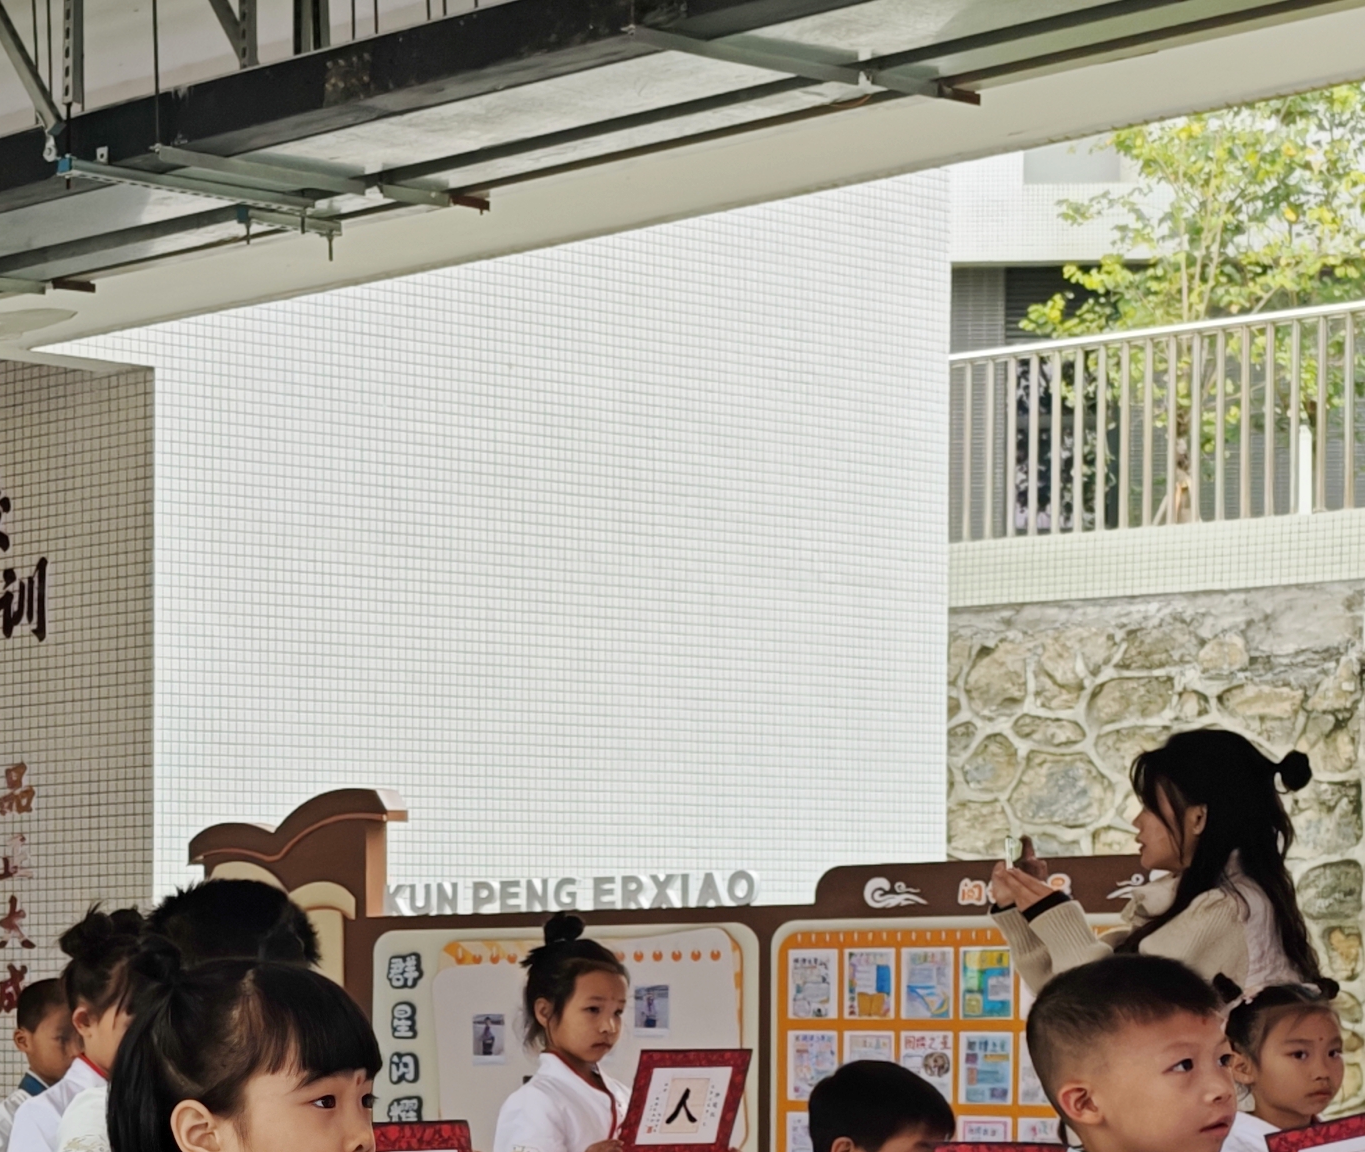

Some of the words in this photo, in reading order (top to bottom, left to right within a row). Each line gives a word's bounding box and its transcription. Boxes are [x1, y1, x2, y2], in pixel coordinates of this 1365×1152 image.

[387, 881, 459, 916] KUN
[472, 877, 578, 913] PENG
[592, 869, 757, 909] ERXIAO
[387, 953, 422, 1122] 群星闪耀
[666, 1088, 697, 1124] 人
